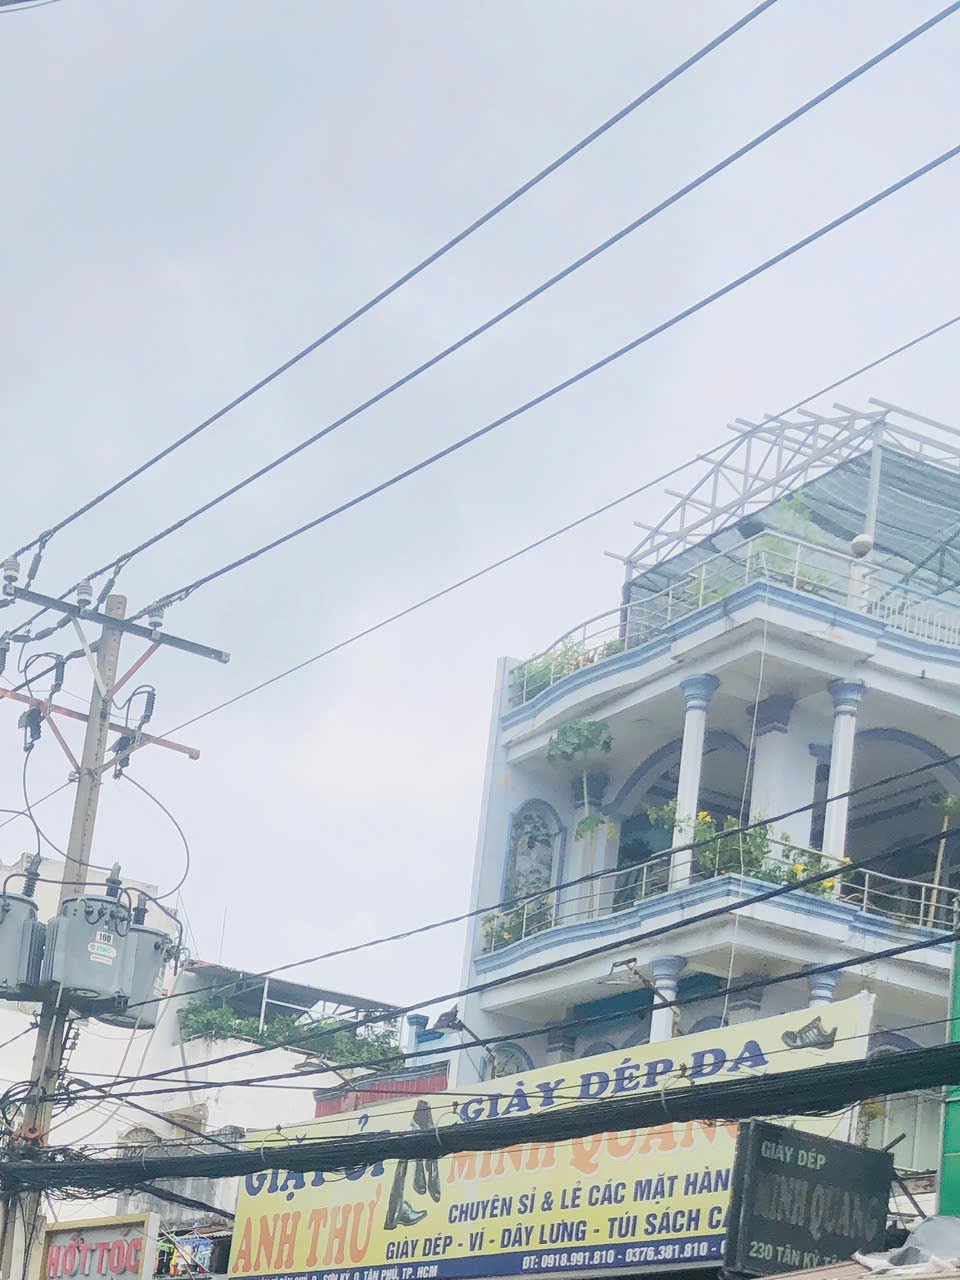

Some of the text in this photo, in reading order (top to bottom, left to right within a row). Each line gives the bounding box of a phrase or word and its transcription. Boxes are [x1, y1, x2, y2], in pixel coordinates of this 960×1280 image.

[459, 1039, 769, 1123] GIÀY DÉP DA
[569, 1122, 739, 1175] QUAN
[760, 1139, 827, 1170] GIÀY DÉP
[448, 1166, 731, 1224] CHUYÊN SỈ & LẺ CÁC MẶT HÀN
[48, 1228, 143, 1279] HỚT TÓC
[231, 1183, 383, 1274] ANH THƯ
[386, 1236, 419, 1260] GIÀY
[422, 1232, 453, 1257] DÉP
[469, 1227, 486, 1252] VÍ
[500, 1222, 534, 1249] DÂY
[608, 1211, 638, 1239] TÚI
[643, 1207, 701, 1236] SÁCH
[748, 1240, 773, 1260] 230
[776, 1244, 801, 1267] TÂN
[417, 1265, 438, 1278] HCM
[522, 1256, 539, 1270] ĐT:
[540, 1249, 615, 1268] 0918.991.810
[625, 1241, 708, 1262] 0376.381.810
